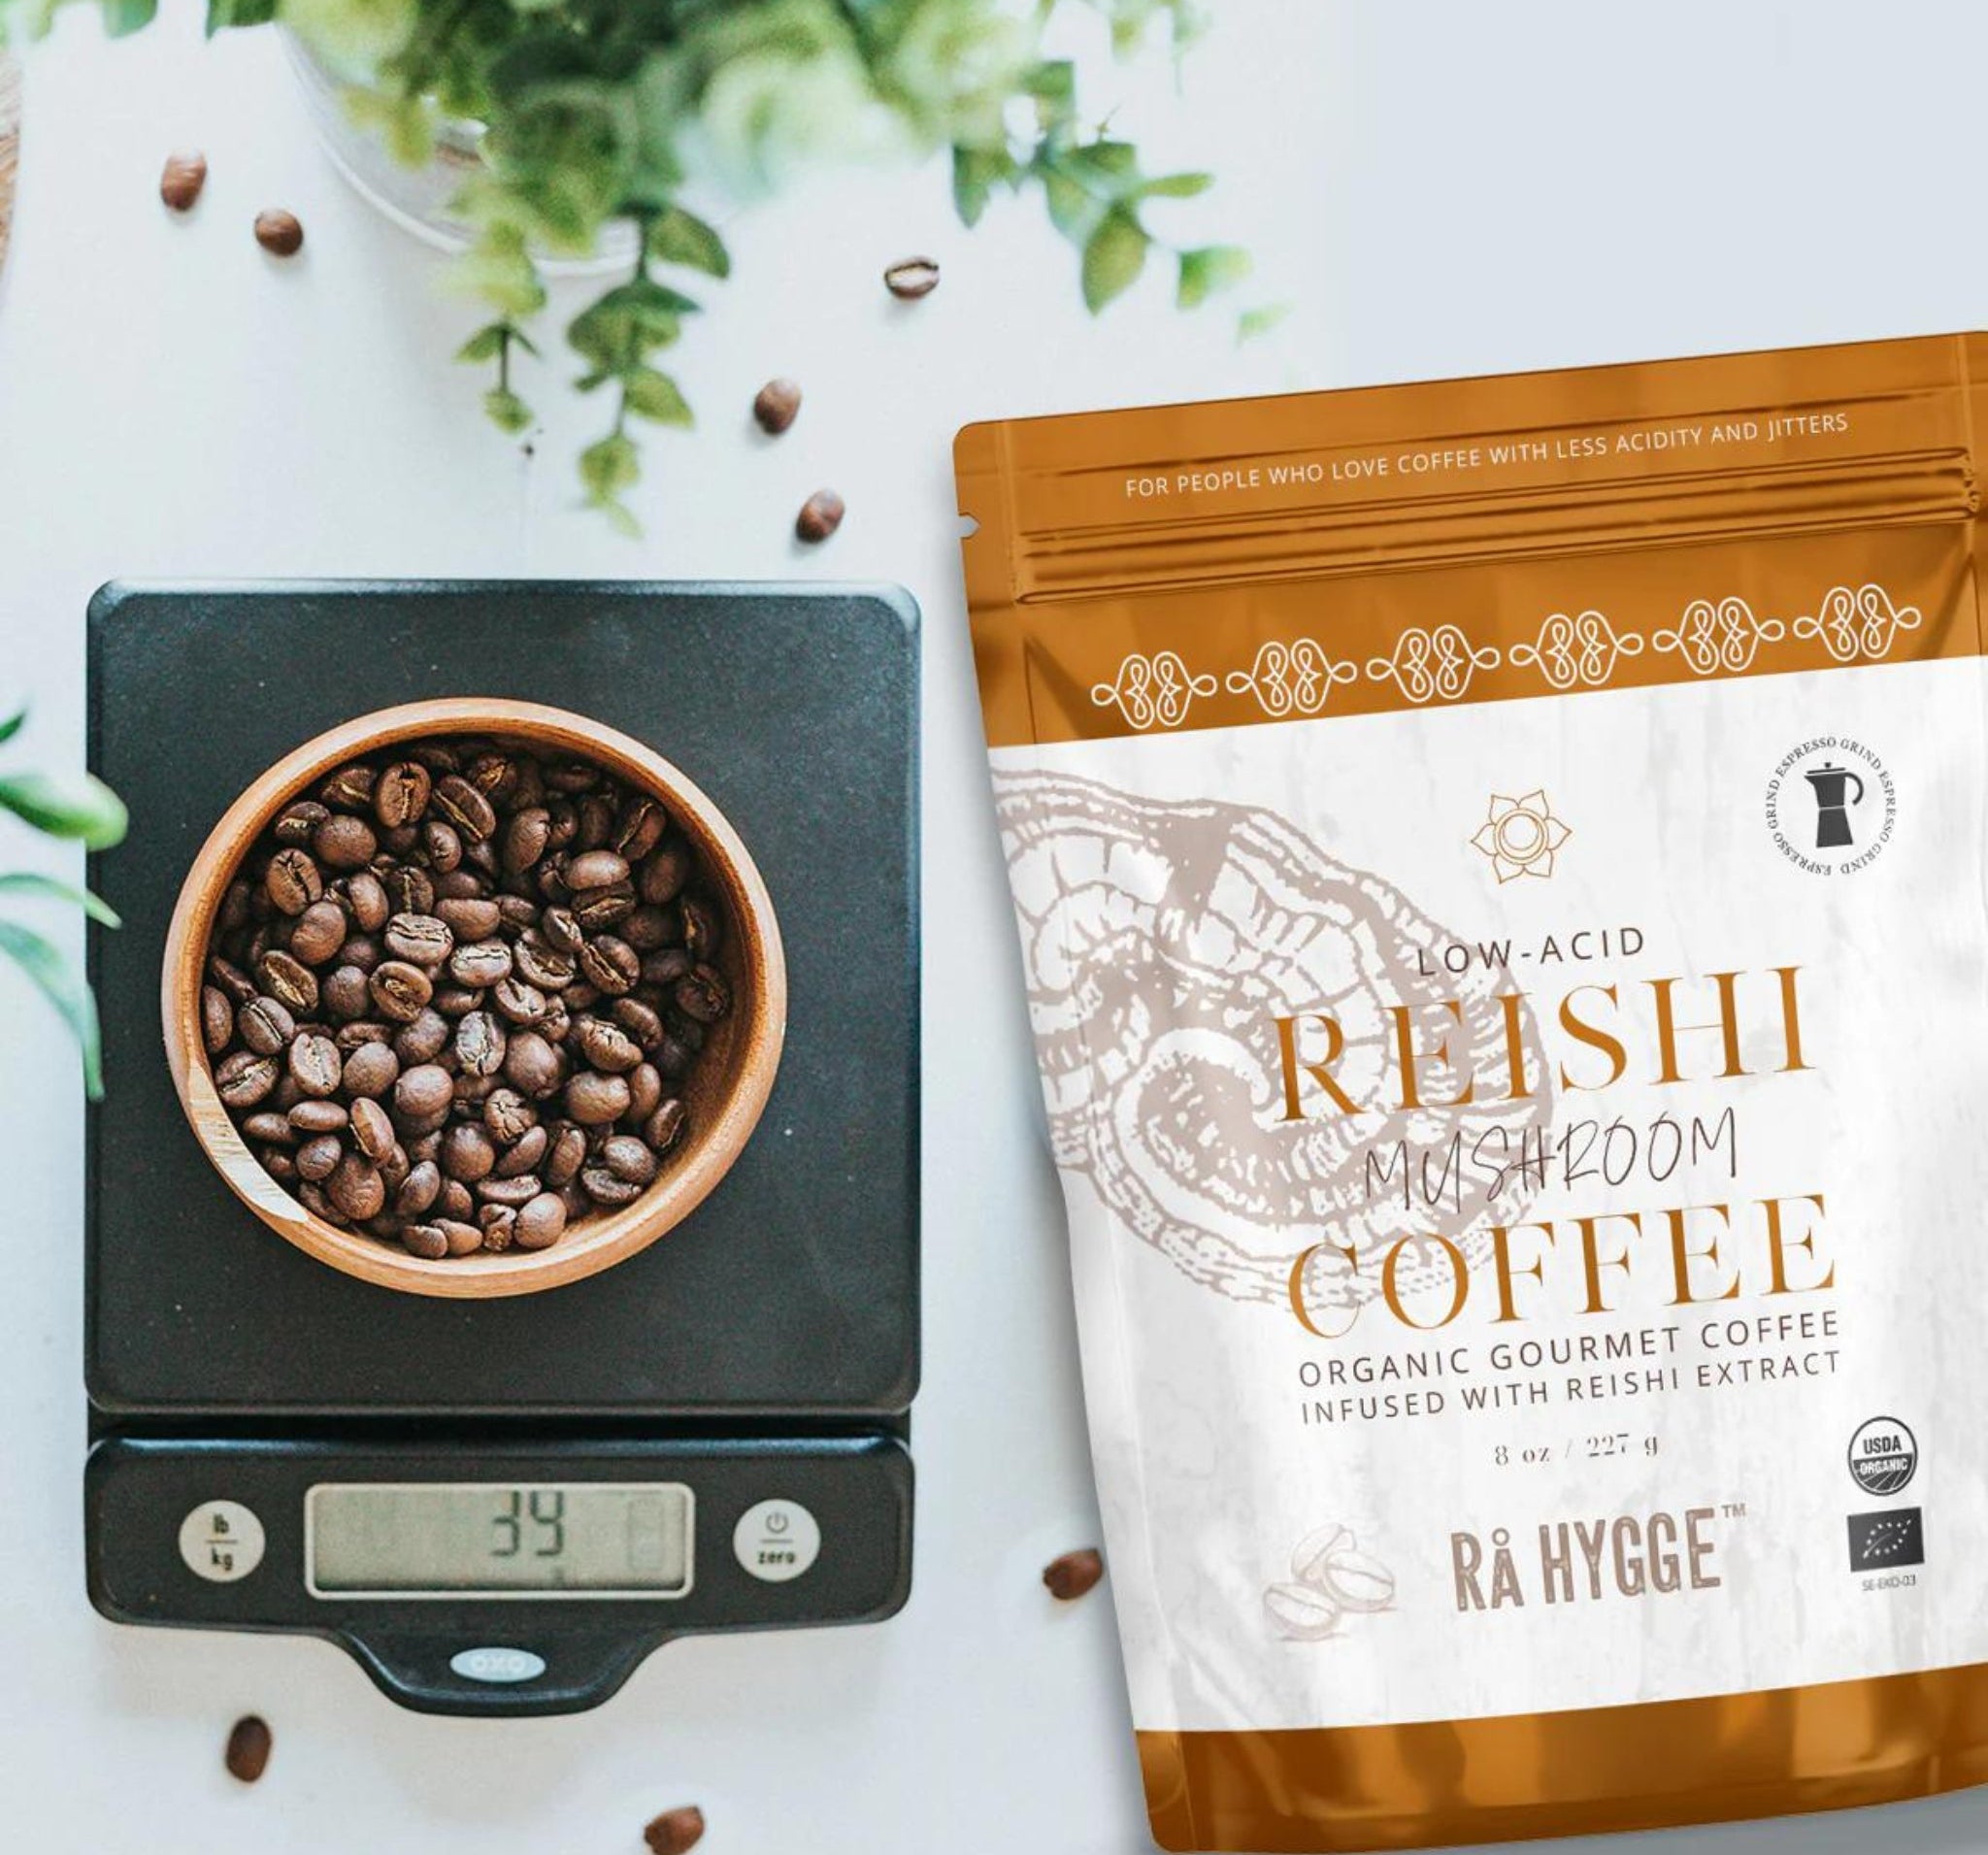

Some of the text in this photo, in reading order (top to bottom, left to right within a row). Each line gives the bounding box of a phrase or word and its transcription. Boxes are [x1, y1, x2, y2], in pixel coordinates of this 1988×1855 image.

[1126, 413, 1848, 498] FOR PEOPLE WHO LOVE COFFEE WITH LESS ACIDITY AND JITTERS
[1766, 737, 1896, 876] ESPRESSO GRIND ESPRESSO GRIND ESPRESSO GRIND
[1417, 927, 1645, 977] LOW-ACID
[1271, 966, 1816, 1123] REISHI
[1363, 1107, 1738, 1213] MUSHROOM
[1287, 1194, 1836, 1339] COFFEE
[1299, 1309, 1839, 1388] ORGANIC GOURMET COFFEE
[1302, 1350, 1840, 1424] INFUSED WITH REISHI EXTRACT
[1494, 1434, 1659, 1467] 8 oz / 227 g
[1859, 1457, 1908, 1475] ORGANIC
[1863, 1435, 1903, 1454] USDA
[212, 1546, 233, 1572] kg
[214, 1514, 229, 1534] lb
[758, 1551, 796, 1565] zero
[1450, 1527, 1525, 1612] RÅ
